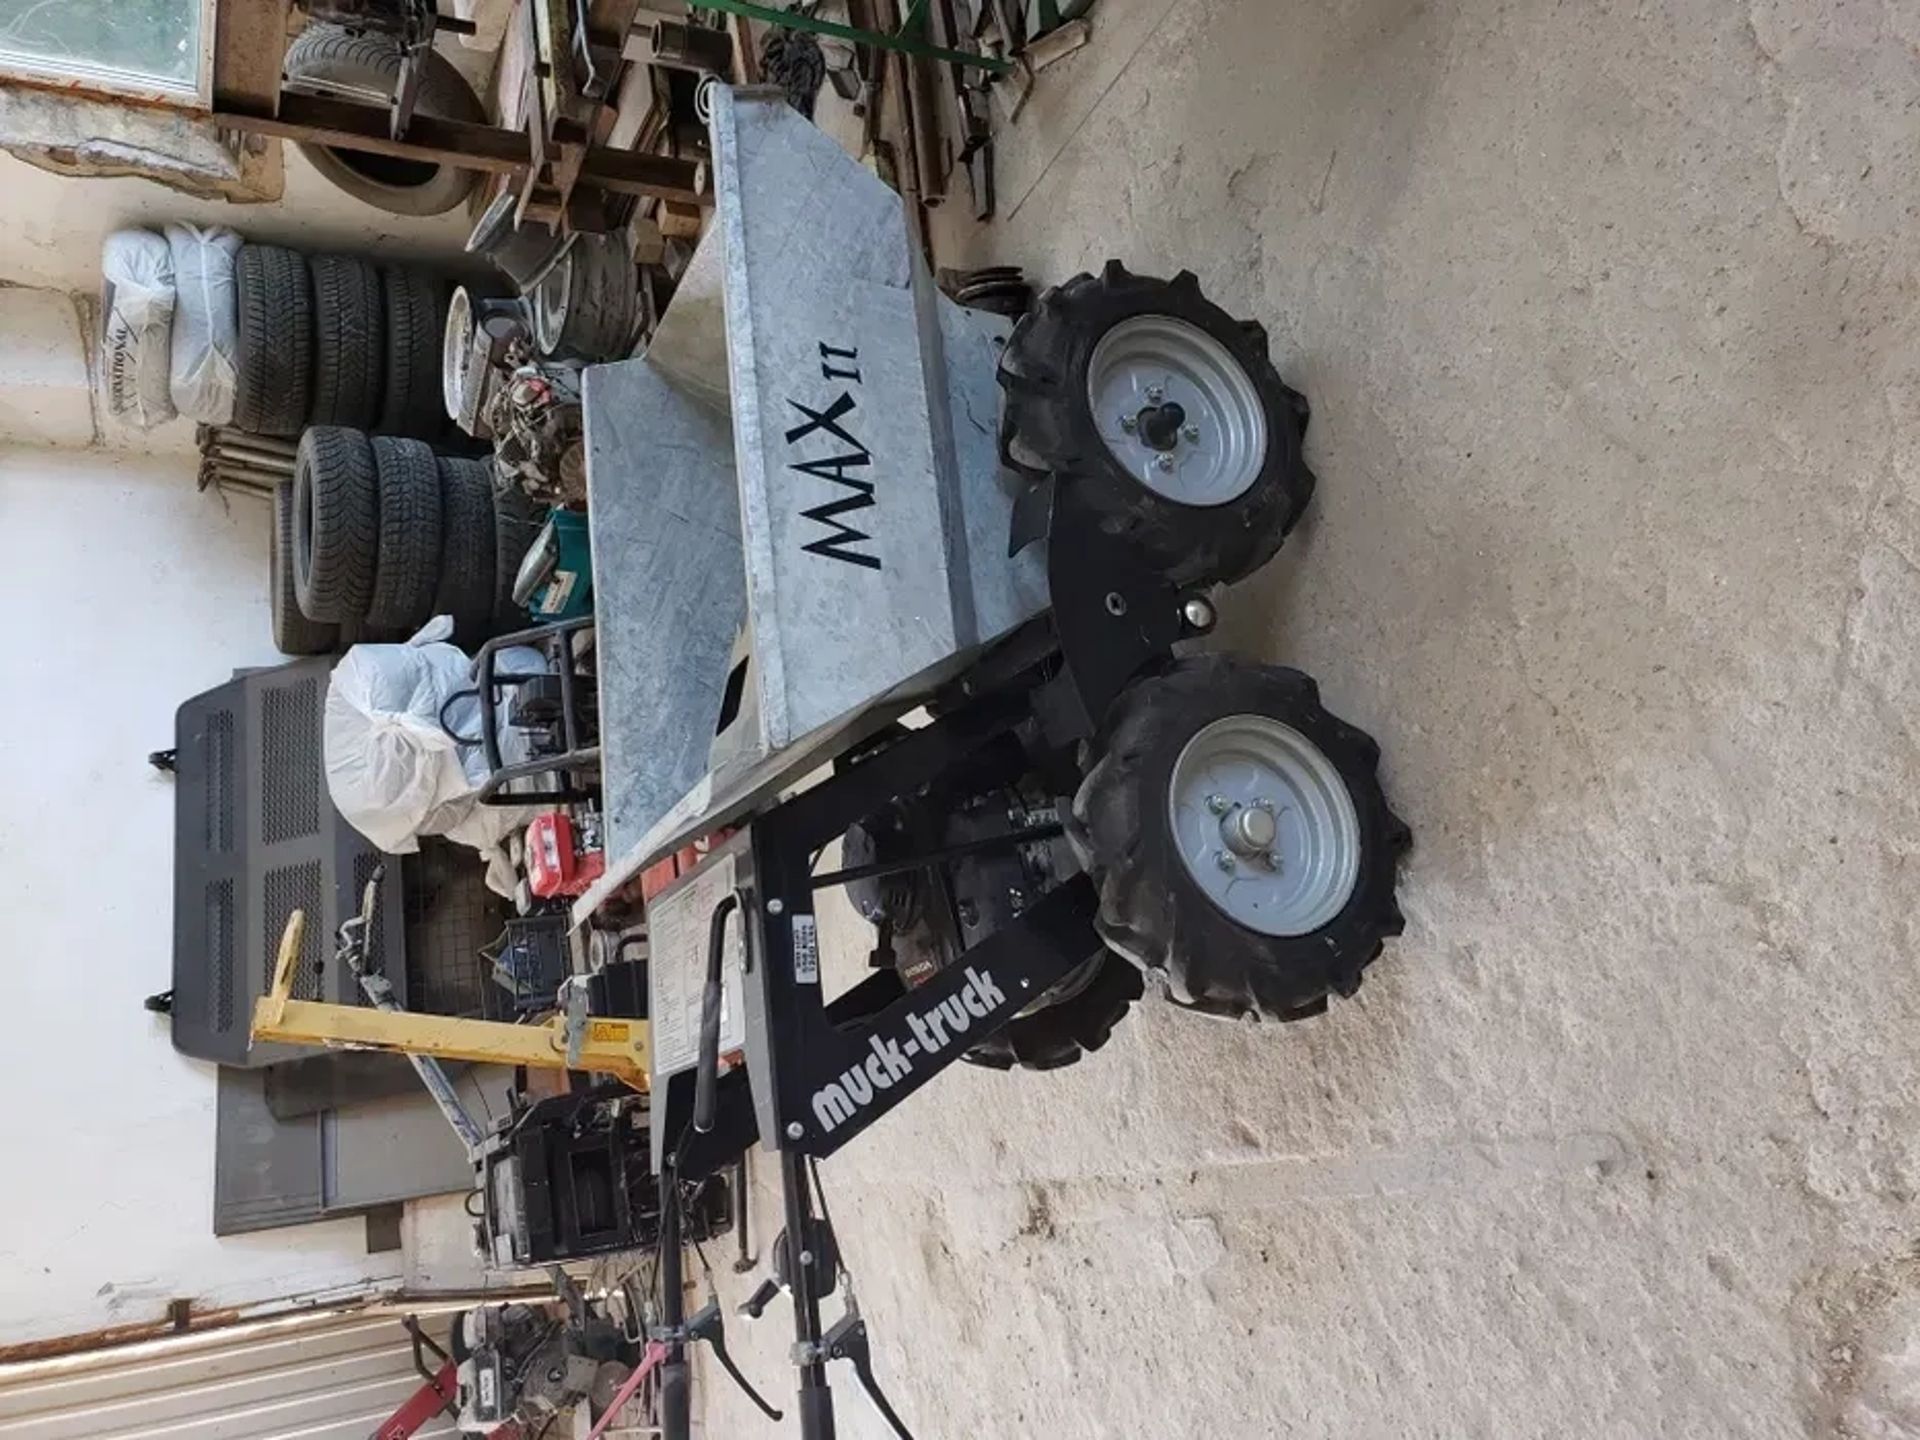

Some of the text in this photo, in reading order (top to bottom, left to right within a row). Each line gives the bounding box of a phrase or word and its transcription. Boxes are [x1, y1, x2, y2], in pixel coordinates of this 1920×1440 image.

[785, 341, 881, 570] MAX II
[812, 966, 1008, 1133] muck-truck
